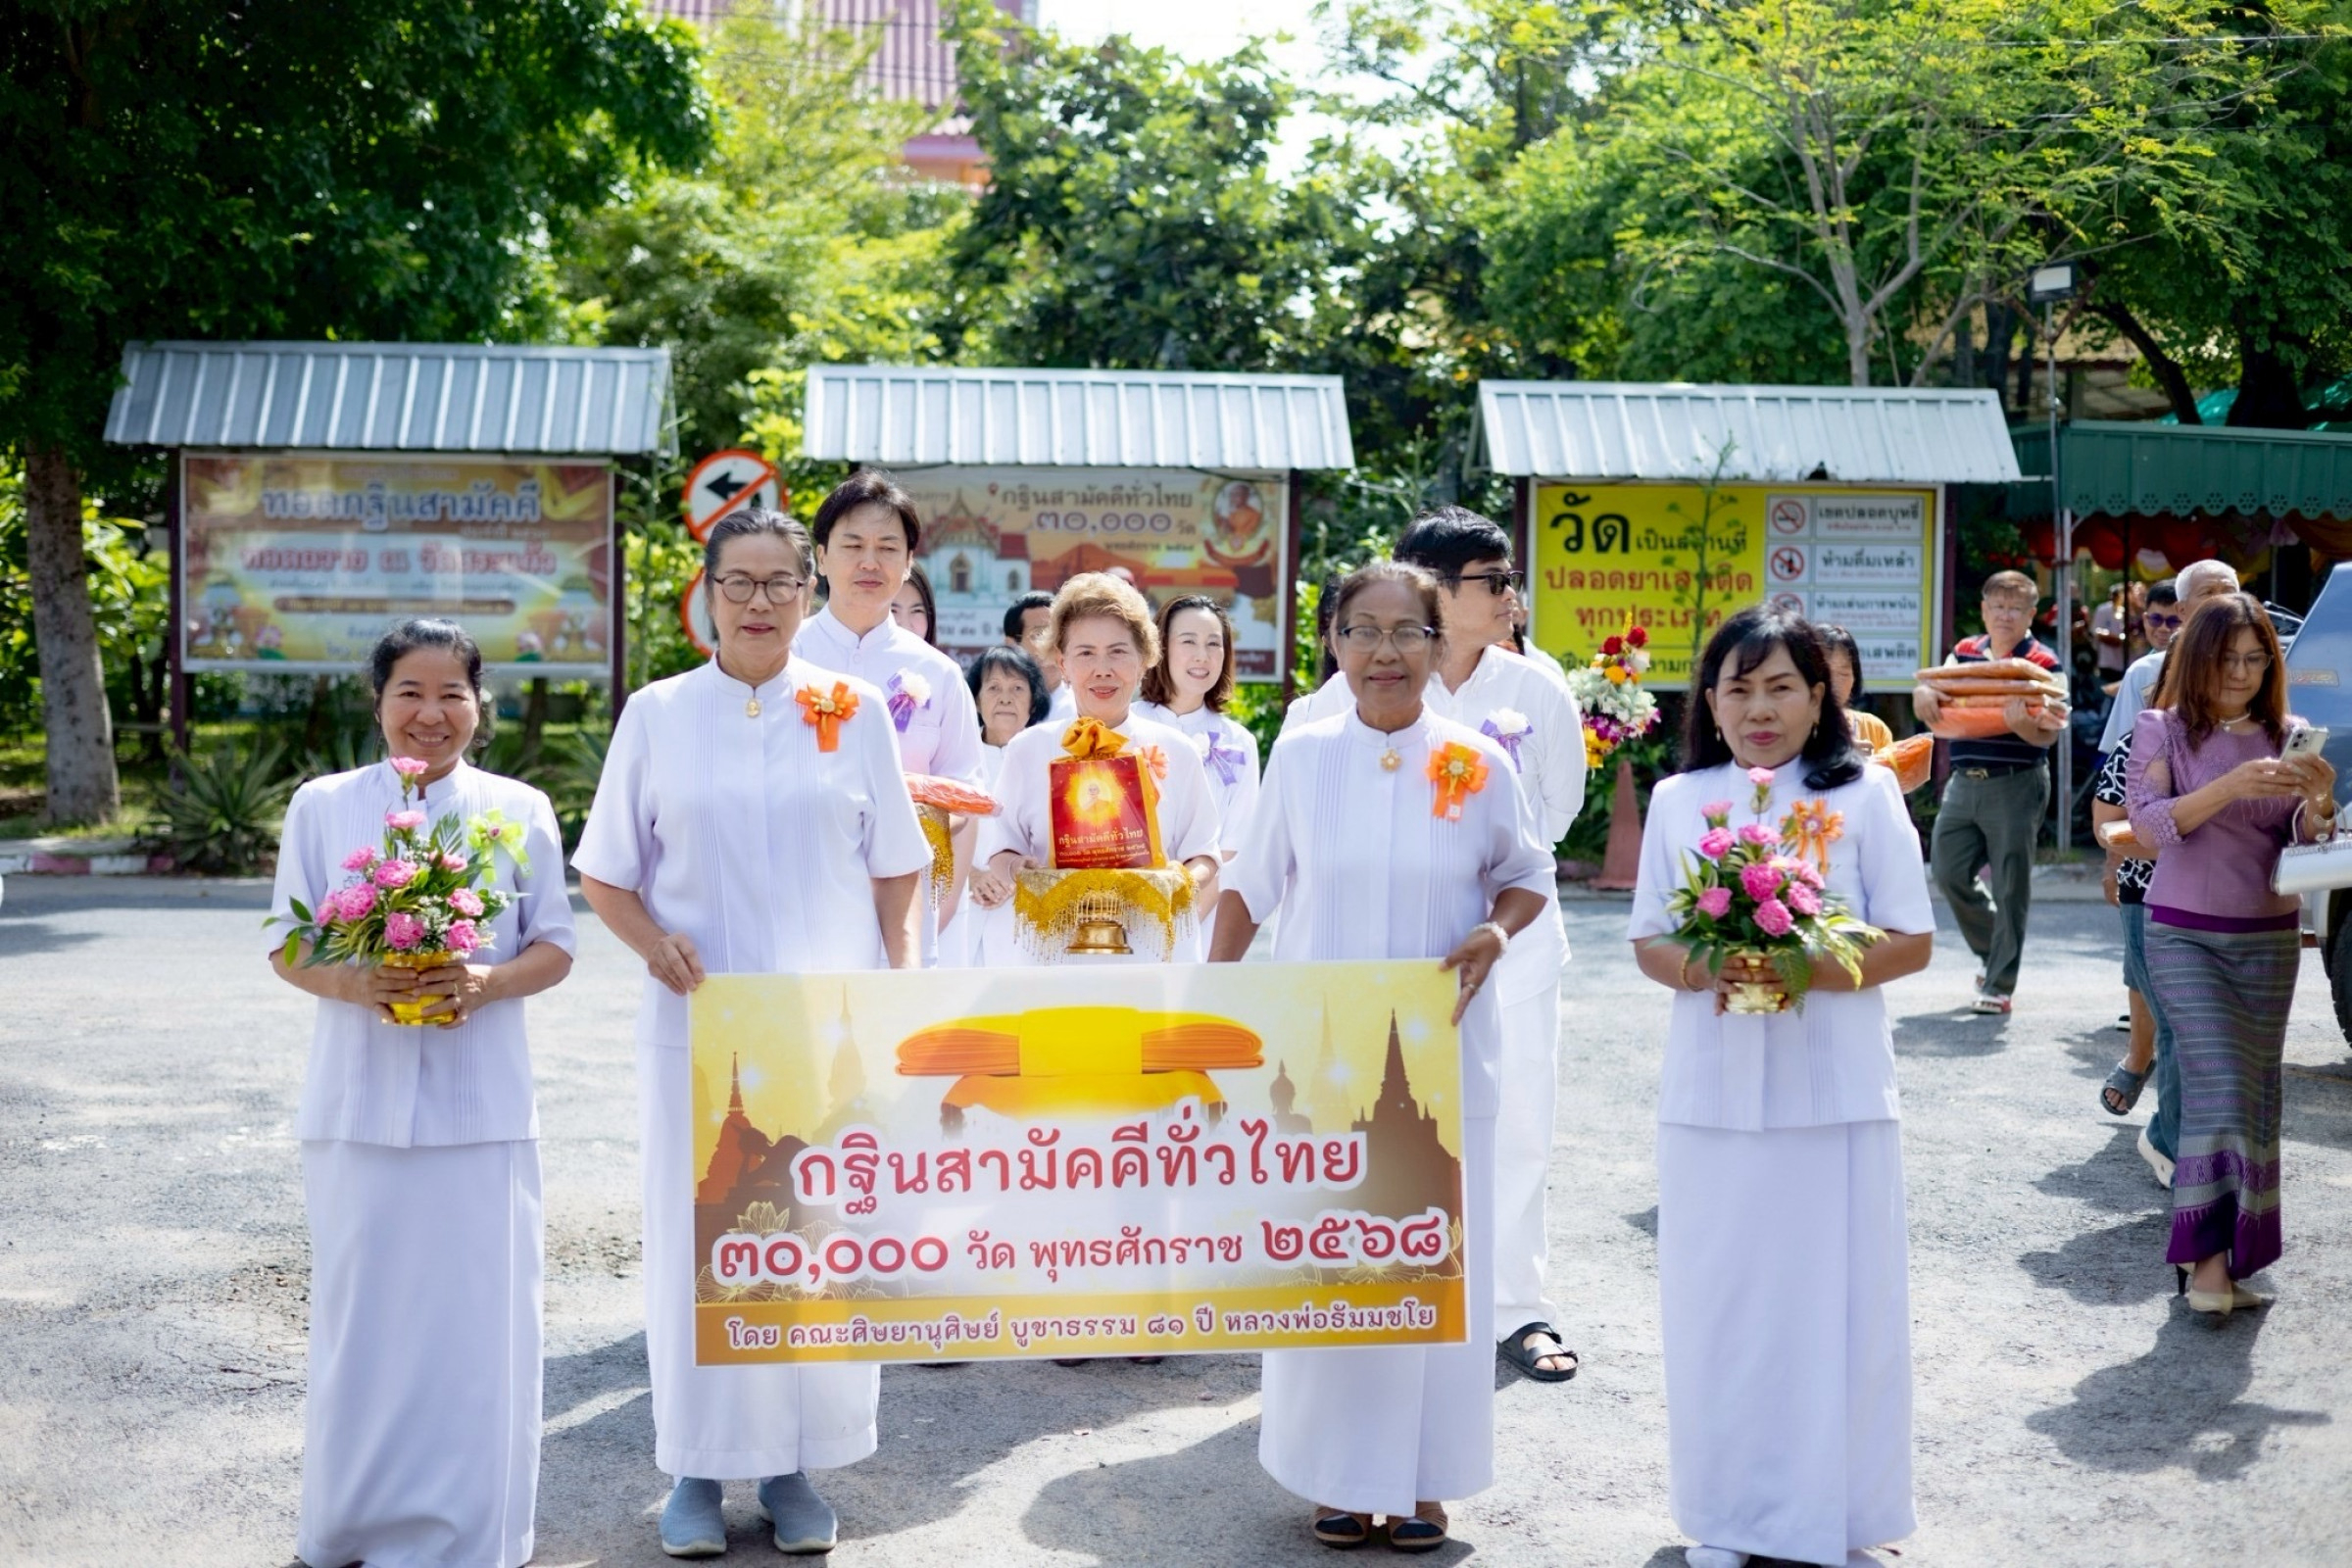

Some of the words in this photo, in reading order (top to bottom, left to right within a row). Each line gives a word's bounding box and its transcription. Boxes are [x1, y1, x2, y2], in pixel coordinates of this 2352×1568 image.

[1002, 479, 1194, 512] กฐินสามัคคีทั่วไทย
[1549, 492, 1631, 554] วัด
[1636, 524, 1747, 552] เป็นสานที่
[799, 1104, 1358, 1215] กฐินสามัคคีทั่วไทย
[720, 1236, 949, 1285] ๓๐,๐๐๐
[966, 1229, 1015, 1270] วัด
[1030, 1226, 1243, 1283] พุทธศักราช
[1261, 1215, 1442, 1261] ๒๕๖๘
[728, 1320, 778, 1348] โดย
[790, 1311, 1000, 1349] คณะศิษยานุศิษย์
[1010, 1314, 1136, 1349] บูชาธรรม
[1148, 1318, 1185, 1335] ๘๑
[1196, 1305, 1213, 1333] ปี
[1224, 1300, 1435, 1334] หลวงพ่อธัมมชโย
